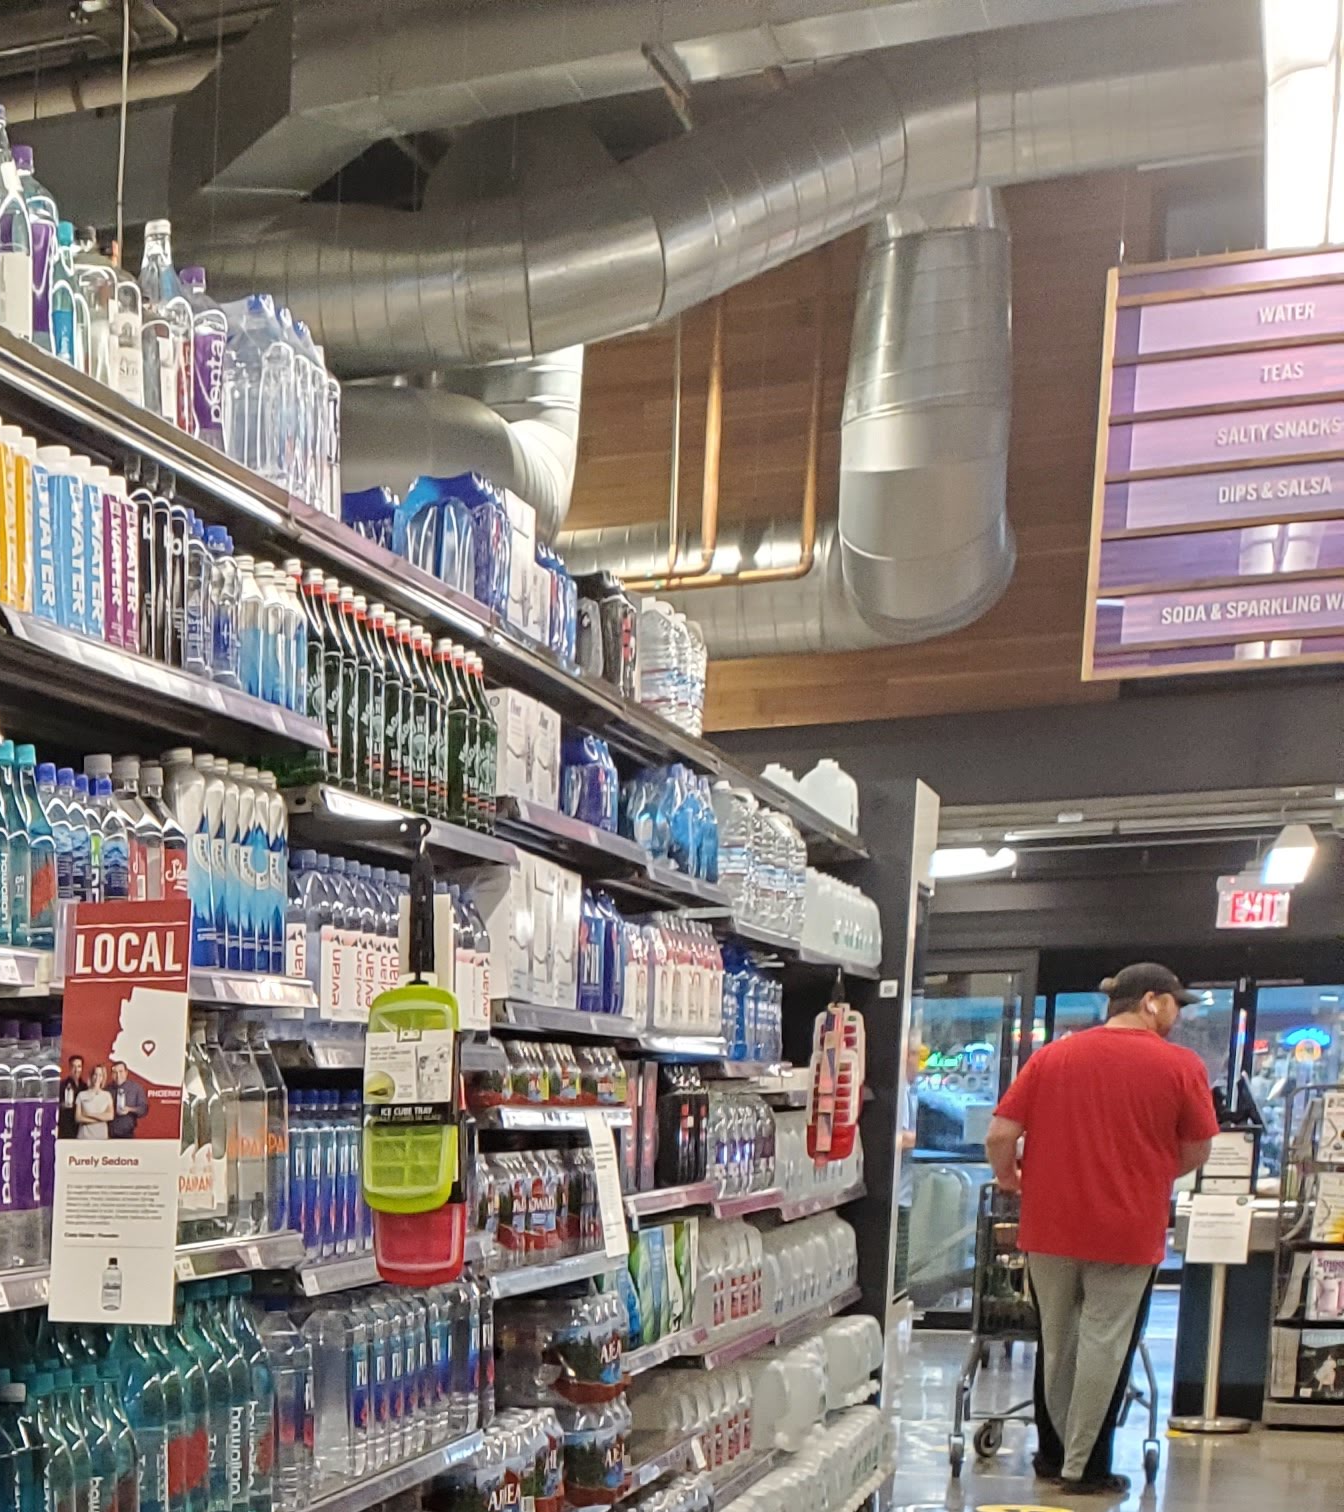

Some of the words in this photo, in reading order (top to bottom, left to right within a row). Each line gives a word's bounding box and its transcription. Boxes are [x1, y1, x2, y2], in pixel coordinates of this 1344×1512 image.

[1258, 302, 1315, 325] WATER
[1261, 361, 1305, 384] TEAS
[1217, 422, 1269, 446] SALTY
[1218, 484, 1257, 504] DIPS
[1261, 483, 1273, 500] &
[1278, 476, 1333, 498] SALSA
[1161, 606, 1206, 625] SODA
[1210, 604, 1223, 620] &
[1226, 594, 1321, 619] SPARKLING
[1230, 889, 1283, 924] EXIT
[75, 932, 182, 975] LOCAL
[330, 949, 342, 1007] evian
[2, 1109, 14, 1204] penta
[32, 1108, 43, 1200] penta
[68, 1155, 99, 1169] Purely
[102, 1156, 139, 1167] Sedona
